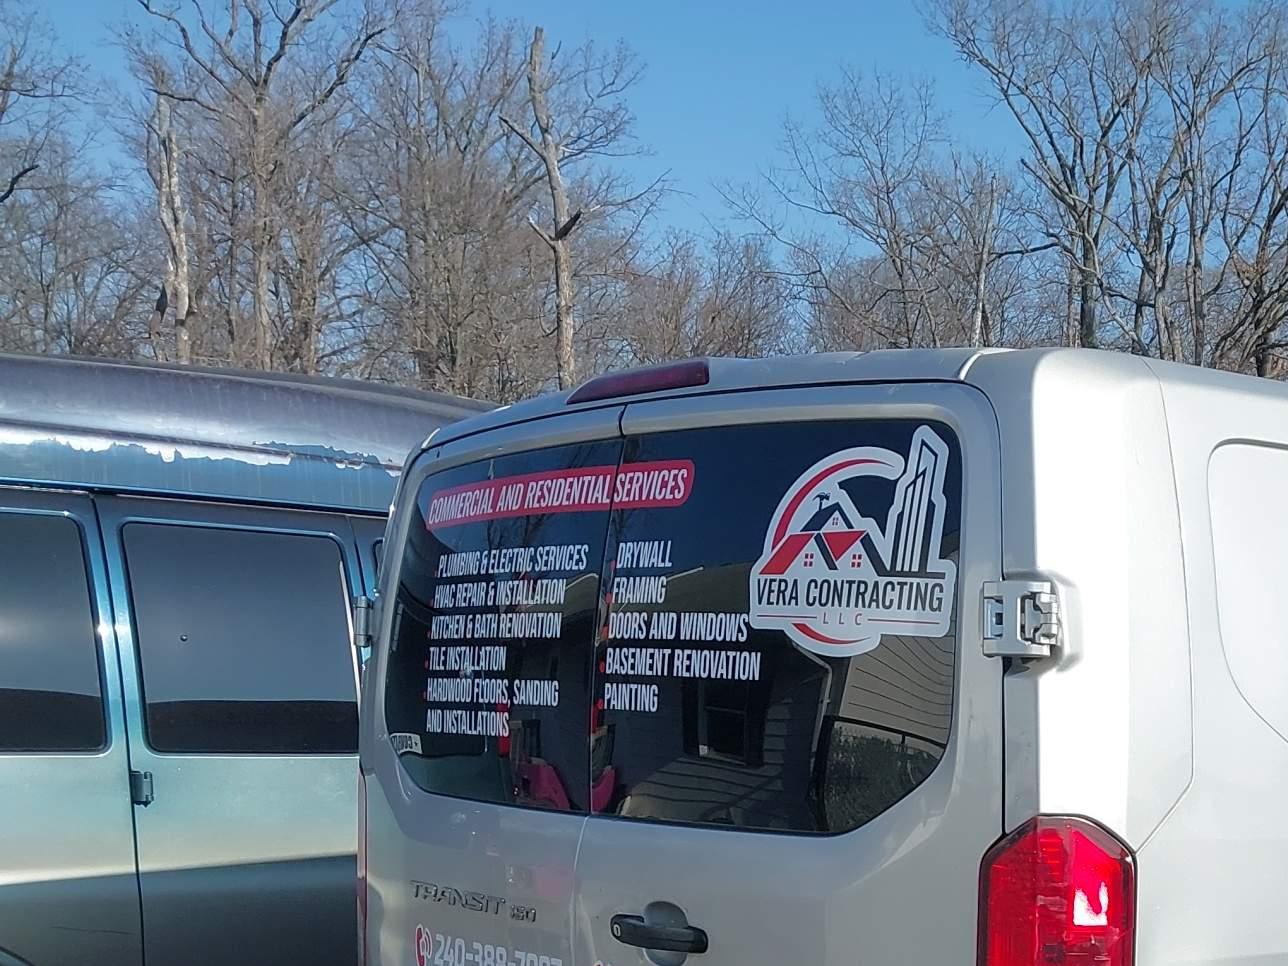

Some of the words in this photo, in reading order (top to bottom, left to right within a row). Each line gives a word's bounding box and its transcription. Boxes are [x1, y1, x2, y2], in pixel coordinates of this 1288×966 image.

[428, 487, 494, 525] COMMERCIAL
[497, 484, 524, 513] AND
[525, 474, 611, 508] RESIDENTIAL
[613, 469, 688, 503] SERVICES
[438, 552, 480, 578] PLUMBING
[480, 551, 487, 575] &
[488, 547, 535, 574] ELECTRIC
[535, 544, 589, 571] SERVICES
[616, 540, 673, 568] DRYWALL
[434, 584, 455, 608] HVAC
[456, 582, 484, 607] REPAIR
[486, 582, 495, 606] &
[496, 578, 567, 606] INSTALLATION
[613, 576, 667, 604] FRAMING
[756, 578, 799, 608] VERA
[805, 578, 945, 613] CONTRACTING
[431, 615, 465, 640] KITCHEN
[466, 614, 473, 639] &
[474, 613, 498, 639] BATH
[499, 612, 562, 639] RENOVATION
[608, 612, 647, 642] DOORS
[648, 613, 678, 641] AND
[679, 612, 749, 643] WINDOWS
[429, 647, 444, 670] TILE
[444, 646, 506, 671] INSTALLATION
[605, 648, 672, 678] BASEMENT
[673, 650, 761, 681] RENOVATION
[427, 678, 472, 703] HARDWOOD
[473, 678, 511, 708] FLOORS,
[513, 680, 559, 707] SANDING
[604, 683, 659, 713] PAINTING
[426, 709, 443, 734] AND
[443, 710, 510, 737] INSTALLATIONS
[410, 880, 506, 915] TRANSIT
